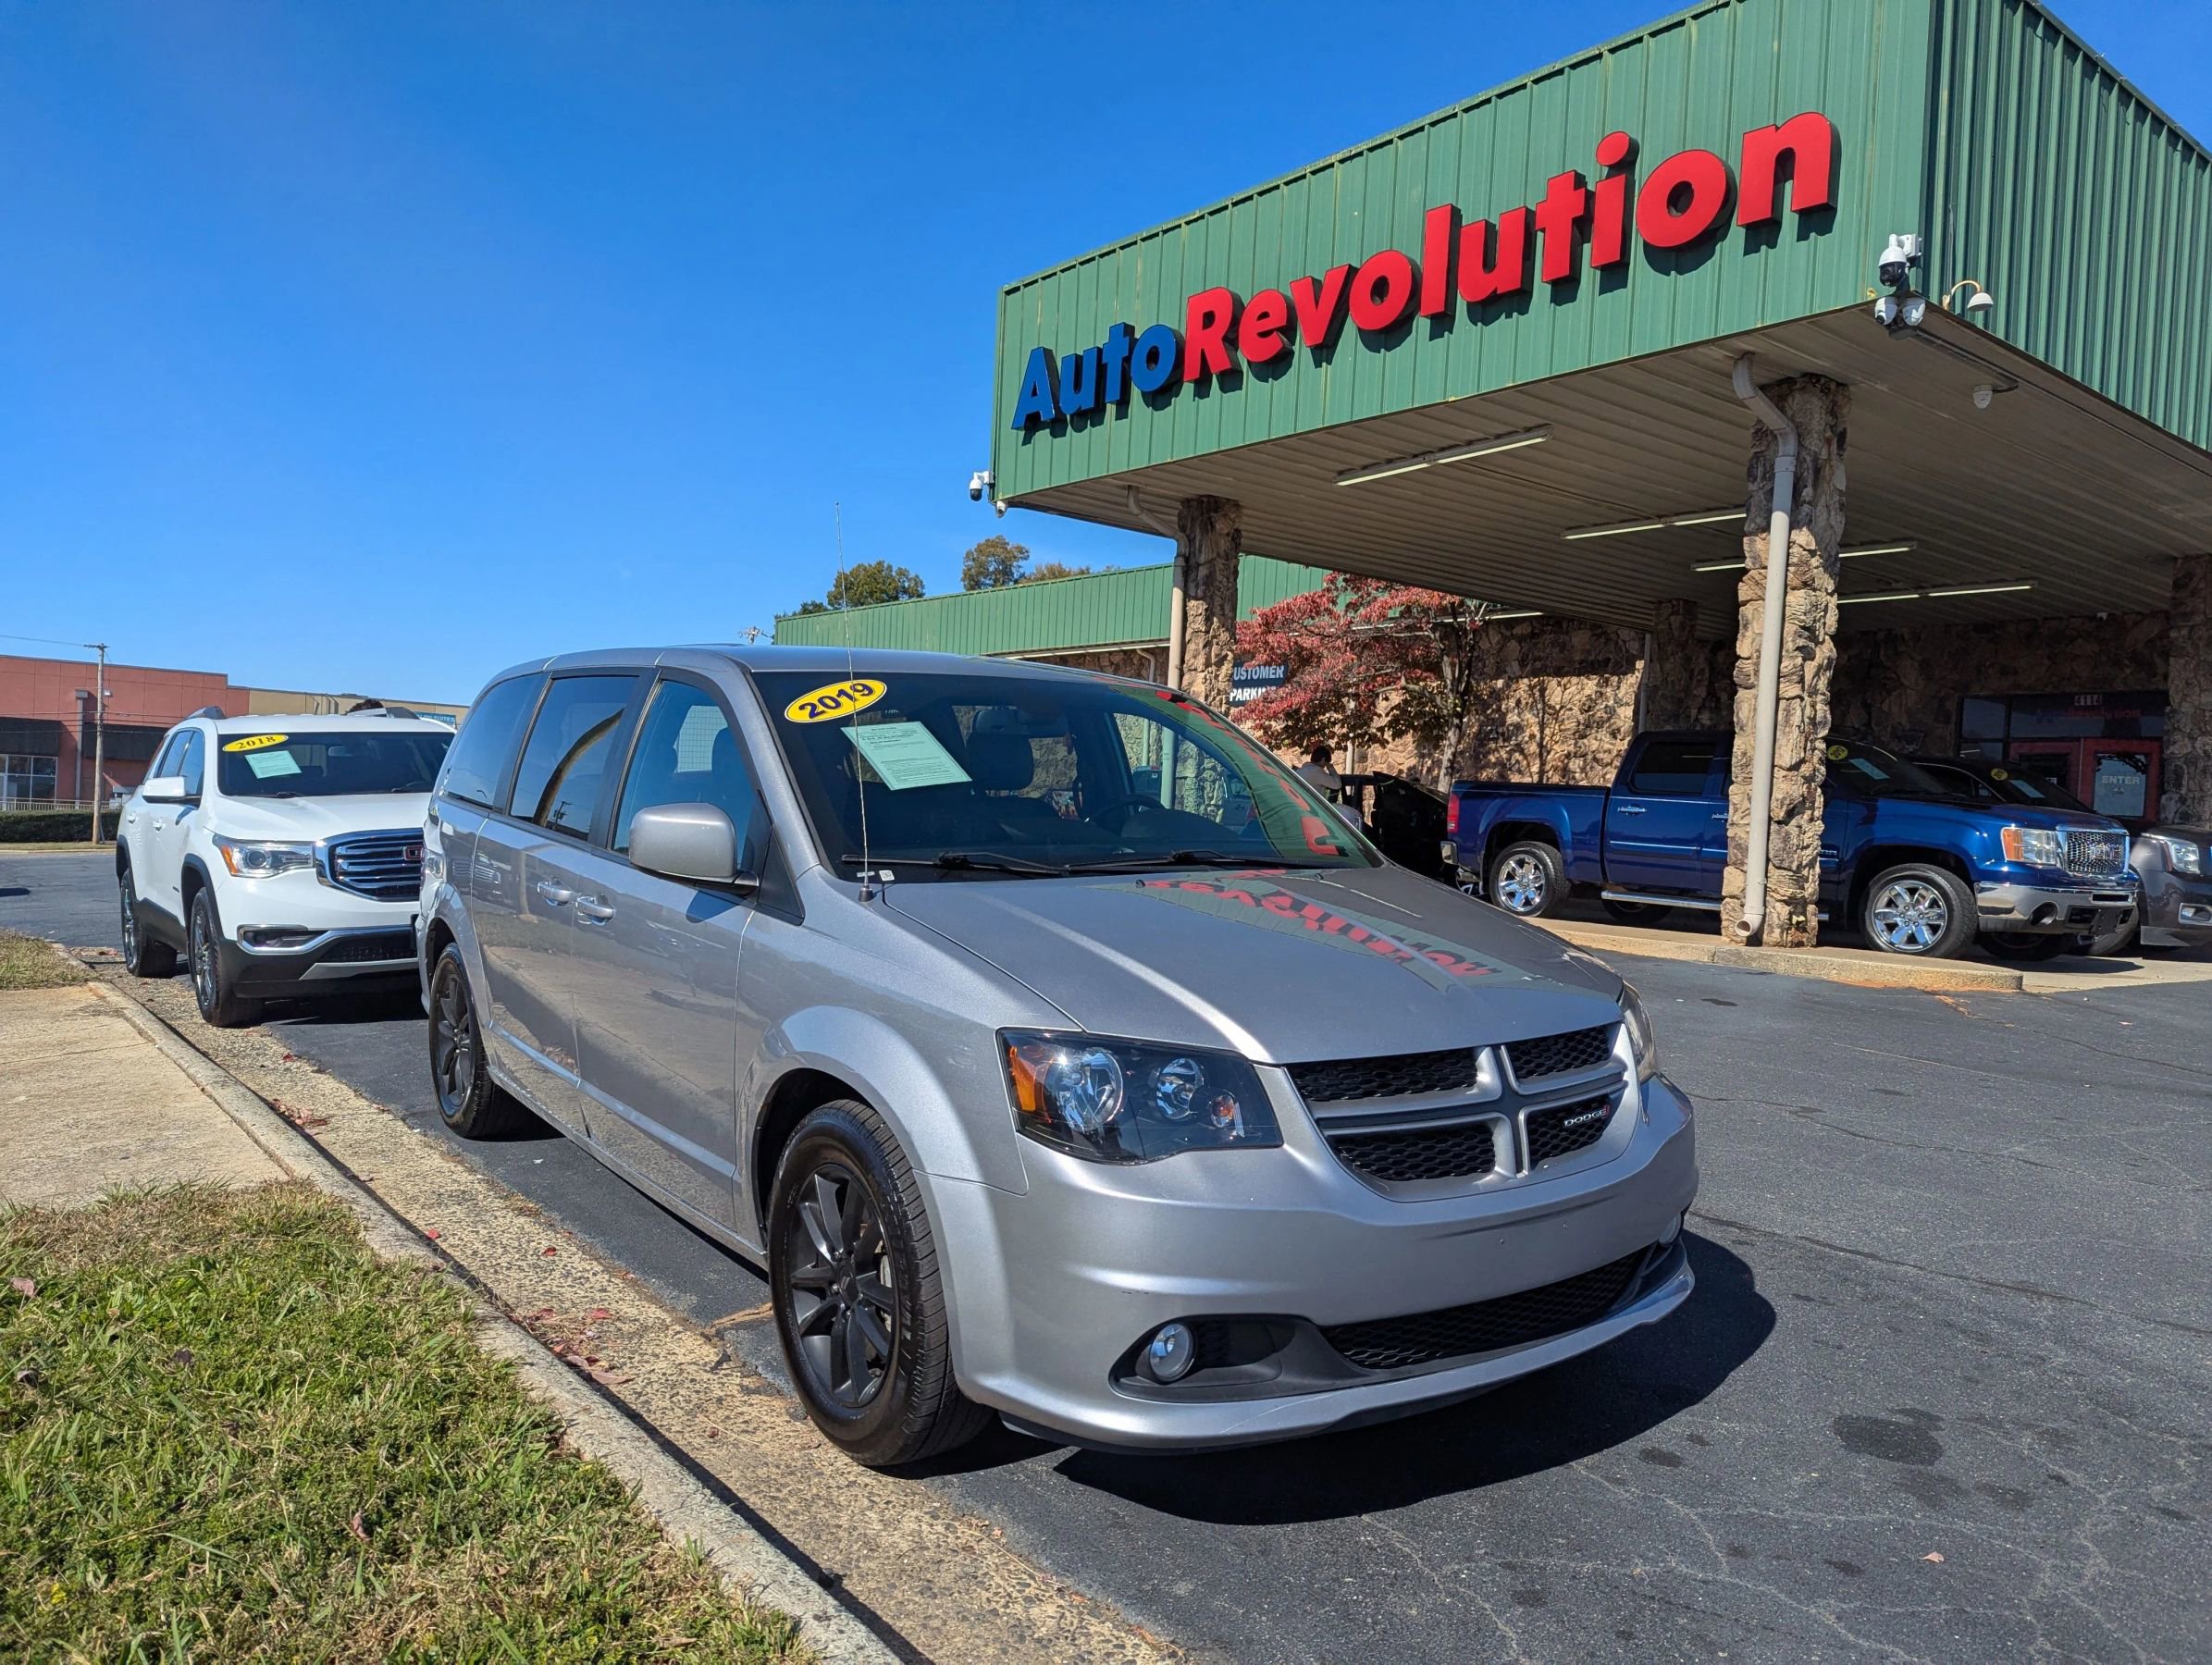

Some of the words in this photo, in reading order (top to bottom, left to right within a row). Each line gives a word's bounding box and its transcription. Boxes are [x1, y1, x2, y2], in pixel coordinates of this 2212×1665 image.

[1232, 664, 1285, 681] USTOMER
[798, 683, 874, 720] 2019
[1229, 686, 1276, 702] PARKI
[238, 736, 276, 749] 2018
[2102, 775, 2140, 785] ENTER
[1563, 1108, 1607, 1127] DODGE
